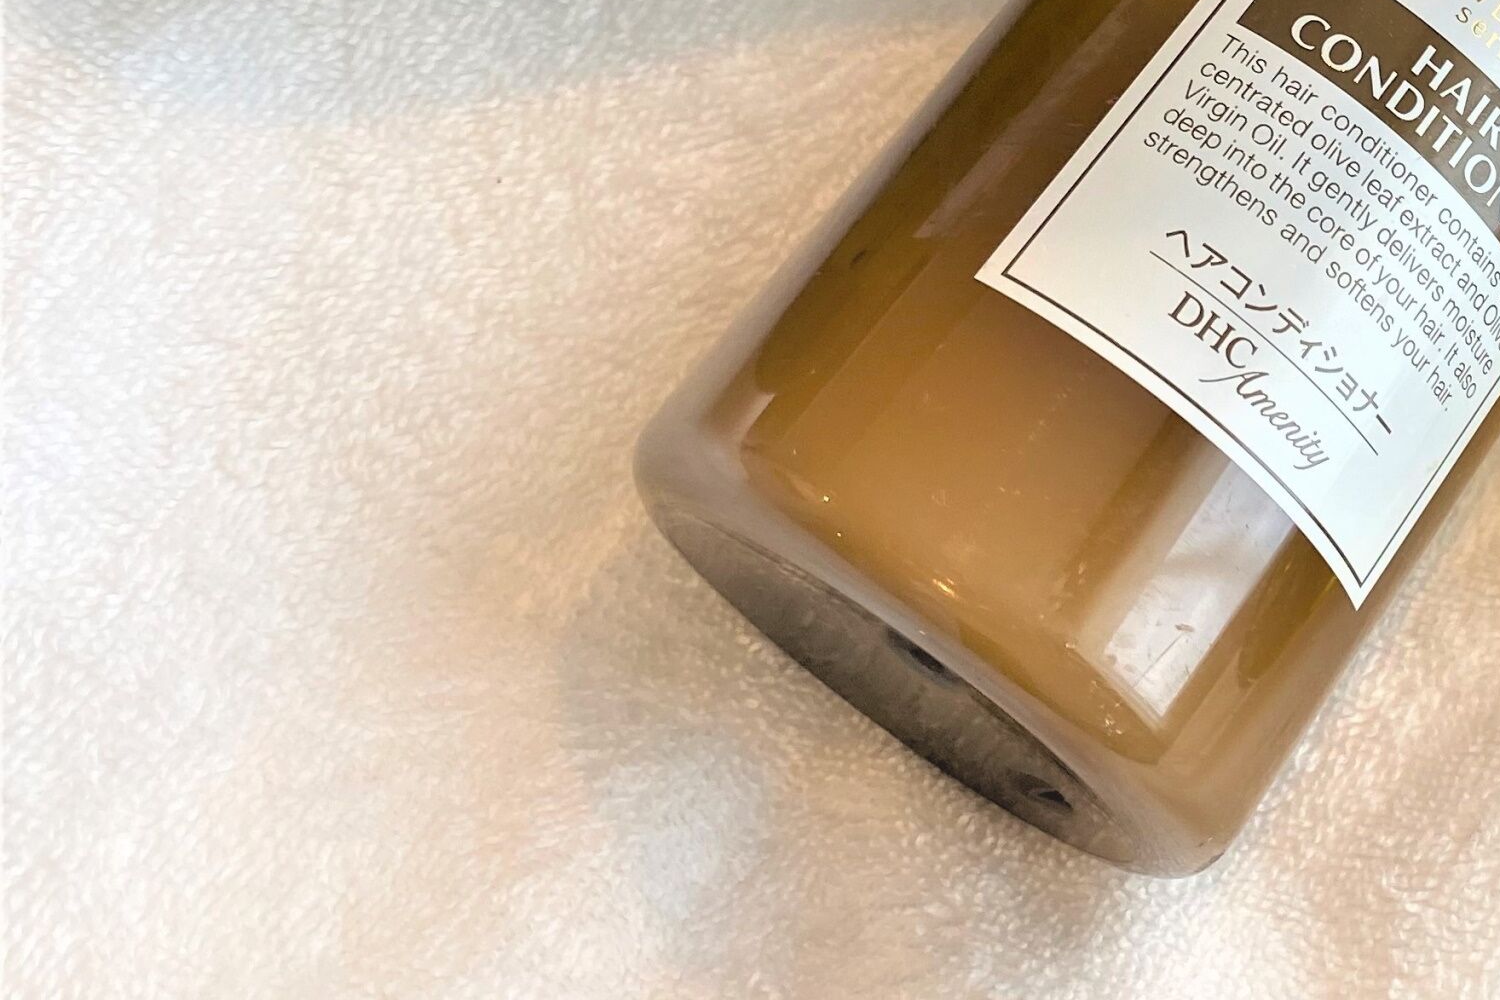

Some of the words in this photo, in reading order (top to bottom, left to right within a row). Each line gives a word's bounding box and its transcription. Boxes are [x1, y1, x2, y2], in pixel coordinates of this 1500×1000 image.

[1143, 131, 1278, 226] strengthens
[1280, 223, 1327, 264] and
[1325, 261, 1394, 332] softens
[1390, 327, 1430, 372] your
[1426, 365, 1452, 411] hair.
[1163, 107, 1222, 149] deep
[1221, 139, 1267, 179] into
[1268, 172, 1306, 209] the
[1306, 206, 1355, 251] core
[1355, 247, 1382, 272] of
[1377, 263, 1417, 312] your
[1413, 304, 1445, 352] hair.
[1443, 341, 1457, 366] It
[1453, 361, 1477, 398] also
[1184, 79, 1248, 131] Virgin
[1251, 123, 1287, 160] Oil.
[1291, 151, 1311, 175] It
[1307, 171, 1378, 231] gently
[1376, 226, 1444, 301] delivers
[1442, 298, 1493, 375] moisture
[1200, 61, 1313, 137] centrated
[1310, 133, 1361, 178] olive
[1360, 168, 1404, 213] leaf
[1399, 209, 1462, 278] extract
[1457, 272, 1489, 311] and
[1219, 32, 1267, 74] This
[1270, 65, 1319, 105] hair
[1320, 104, 1438, 207] conditioner
[1438, 207, 1500, 287] contains
[1165, 230, 1391, 434] ヘアコンディショナー
[1167, 290, 1258, 368] DHC
[1198, 371, 1329, 469] Amenity
